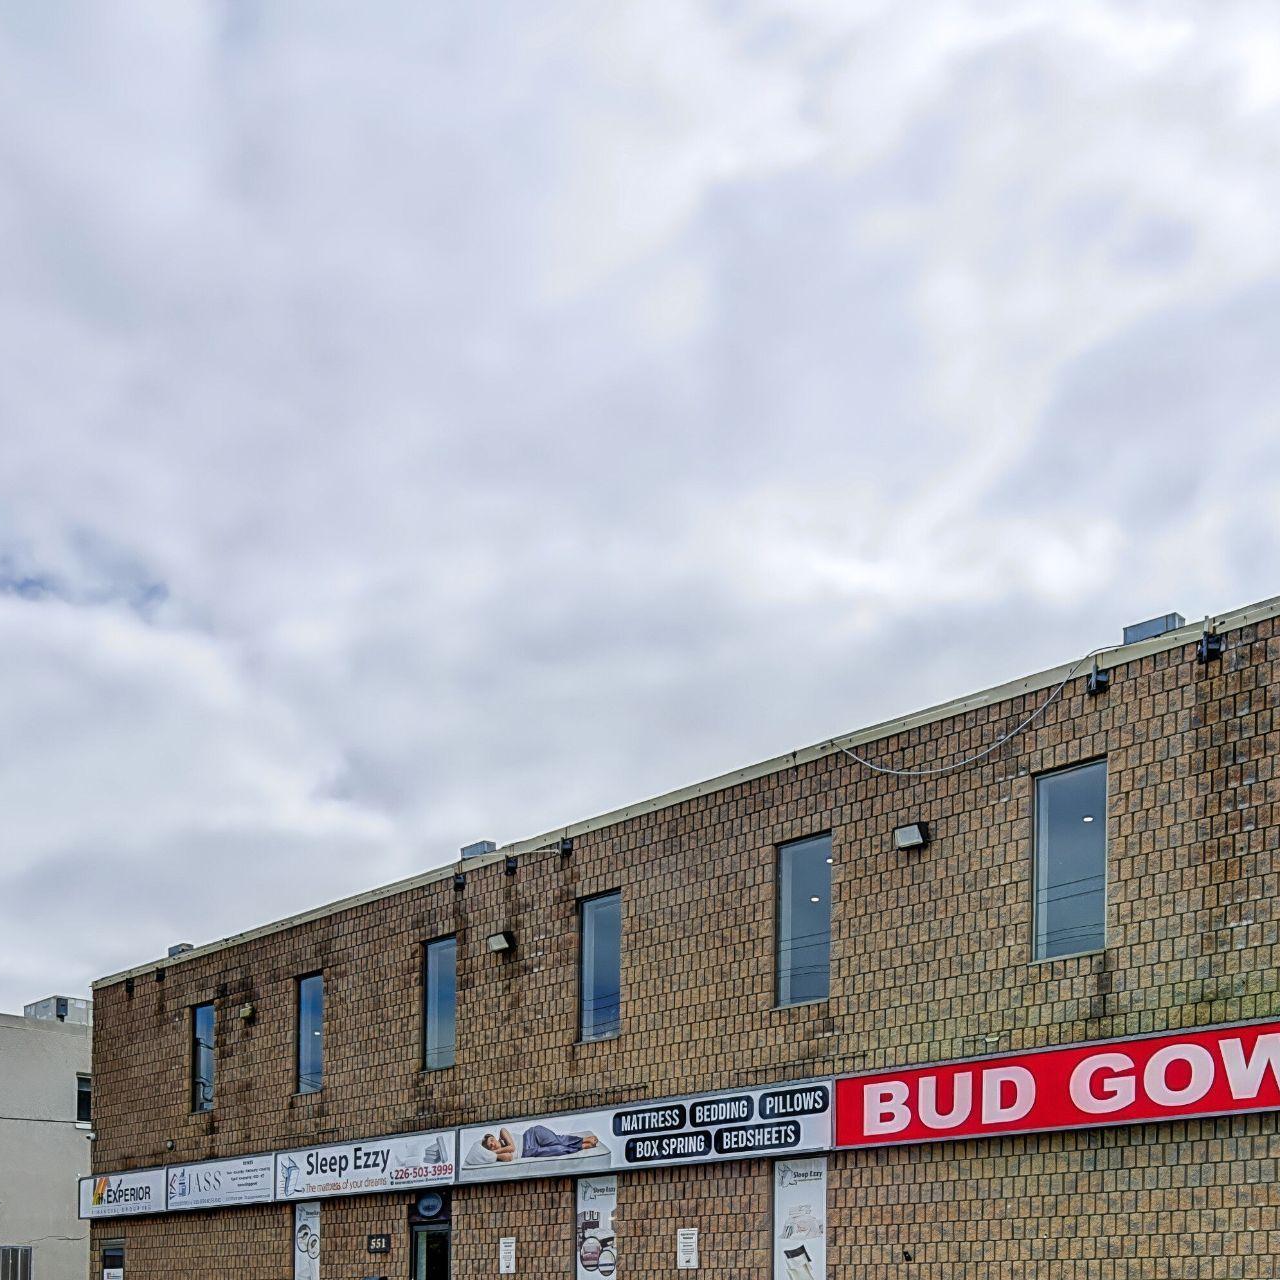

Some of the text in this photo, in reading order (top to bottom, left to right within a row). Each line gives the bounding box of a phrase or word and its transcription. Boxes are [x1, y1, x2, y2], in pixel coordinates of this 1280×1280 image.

[621, 1090, 822, 1132] MATTRESS BEDDING PILLOWS
[862, 1065, 1037, 1138] BUD
[636, 1124, 796, 1158] BOX SPRING BEDSHEETS
[306, 1147, 390, 1178] Sleep Ezzy
[394, 1164, 454, 1180] 226-503-3999
[106, 1181, 150, 1204] EXPERIOR
[188, 1170, 222, 1196] JASS
[306, 1184, 316, 1192] The
[349, 1180, 363, 1190] your
[370, 1238, 386, 1250] 551
